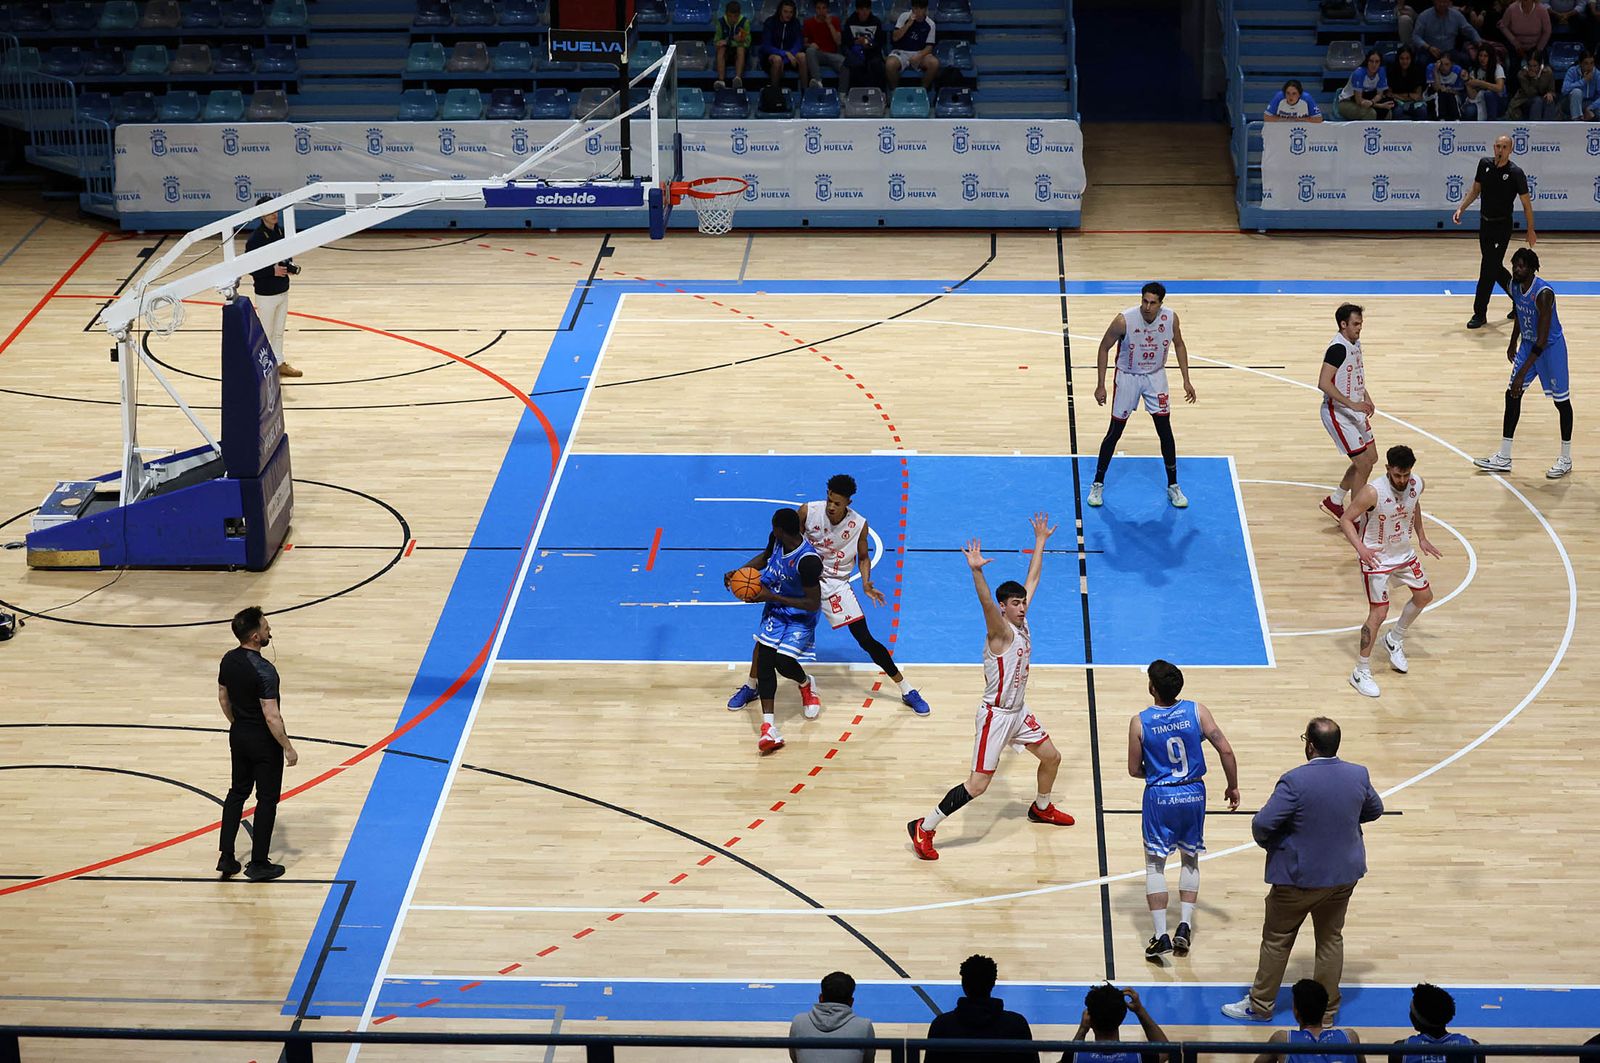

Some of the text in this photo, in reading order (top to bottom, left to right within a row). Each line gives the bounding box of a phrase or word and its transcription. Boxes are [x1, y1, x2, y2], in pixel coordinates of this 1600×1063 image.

[552, 40, 623, 53] HUELVA
[535, 192, 597, 204] schelde
[1143, 352, 1155, 360] 99
[1395, 521, 1401, 532] 5
[1152, 720, 1192, 735] TIMONER
[1166, 736, 1188, 778] 9
